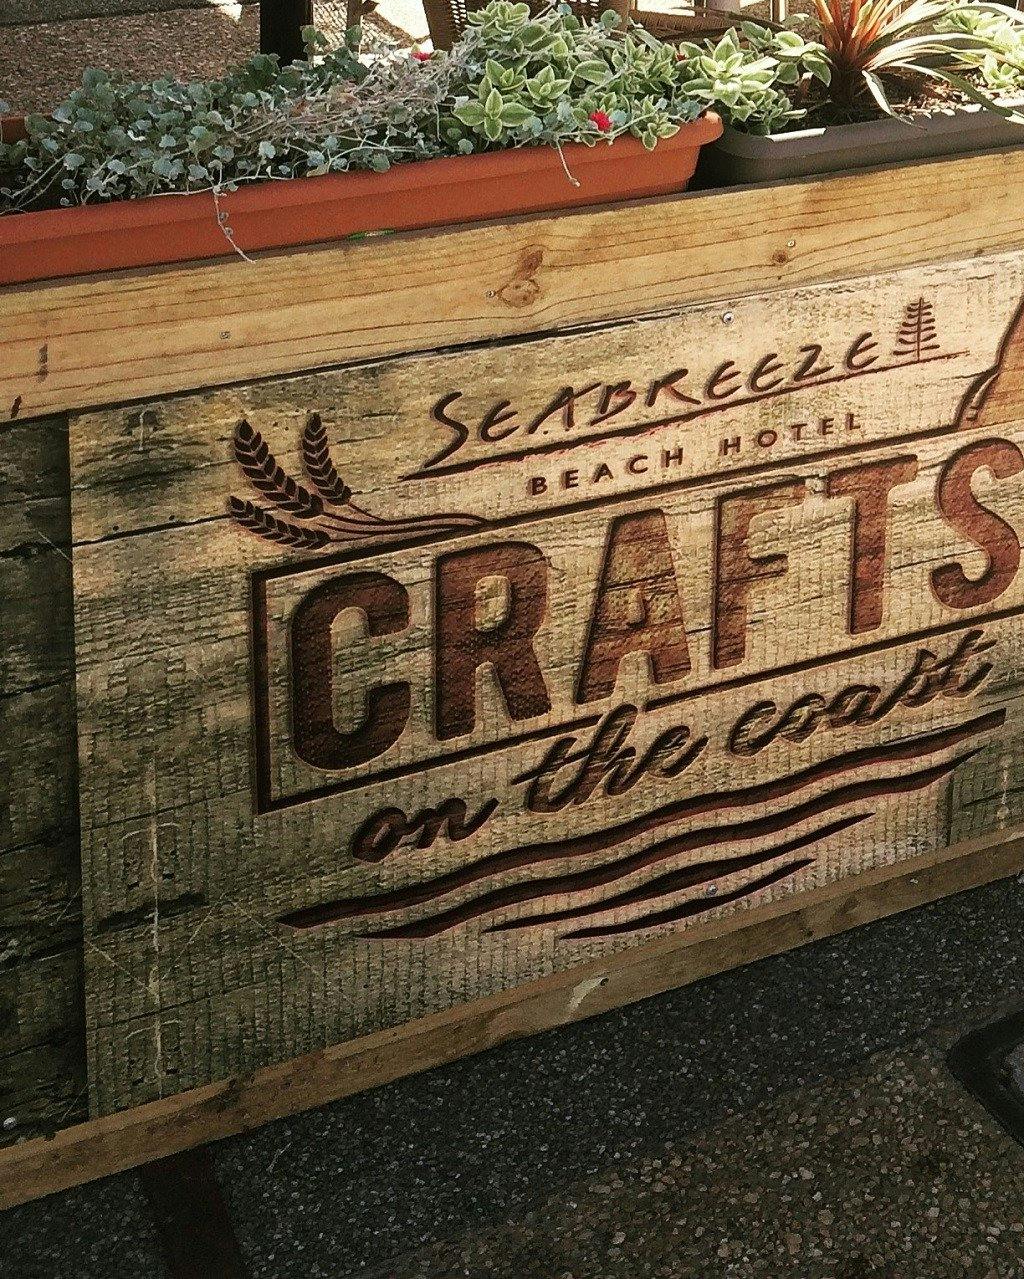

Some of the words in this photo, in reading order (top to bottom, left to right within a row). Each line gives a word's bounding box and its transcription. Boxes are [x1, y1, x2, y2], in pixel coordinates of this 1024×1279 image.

[424, 331, 881, 469] SEABREEZE
[530, 447, 684, 496] BEACH
[719, 413, 863, 457] HOTEL
[350, 796, 499, 862] on
[512, 704, 709, 813] the
[729, 630, 998, 758] coast
